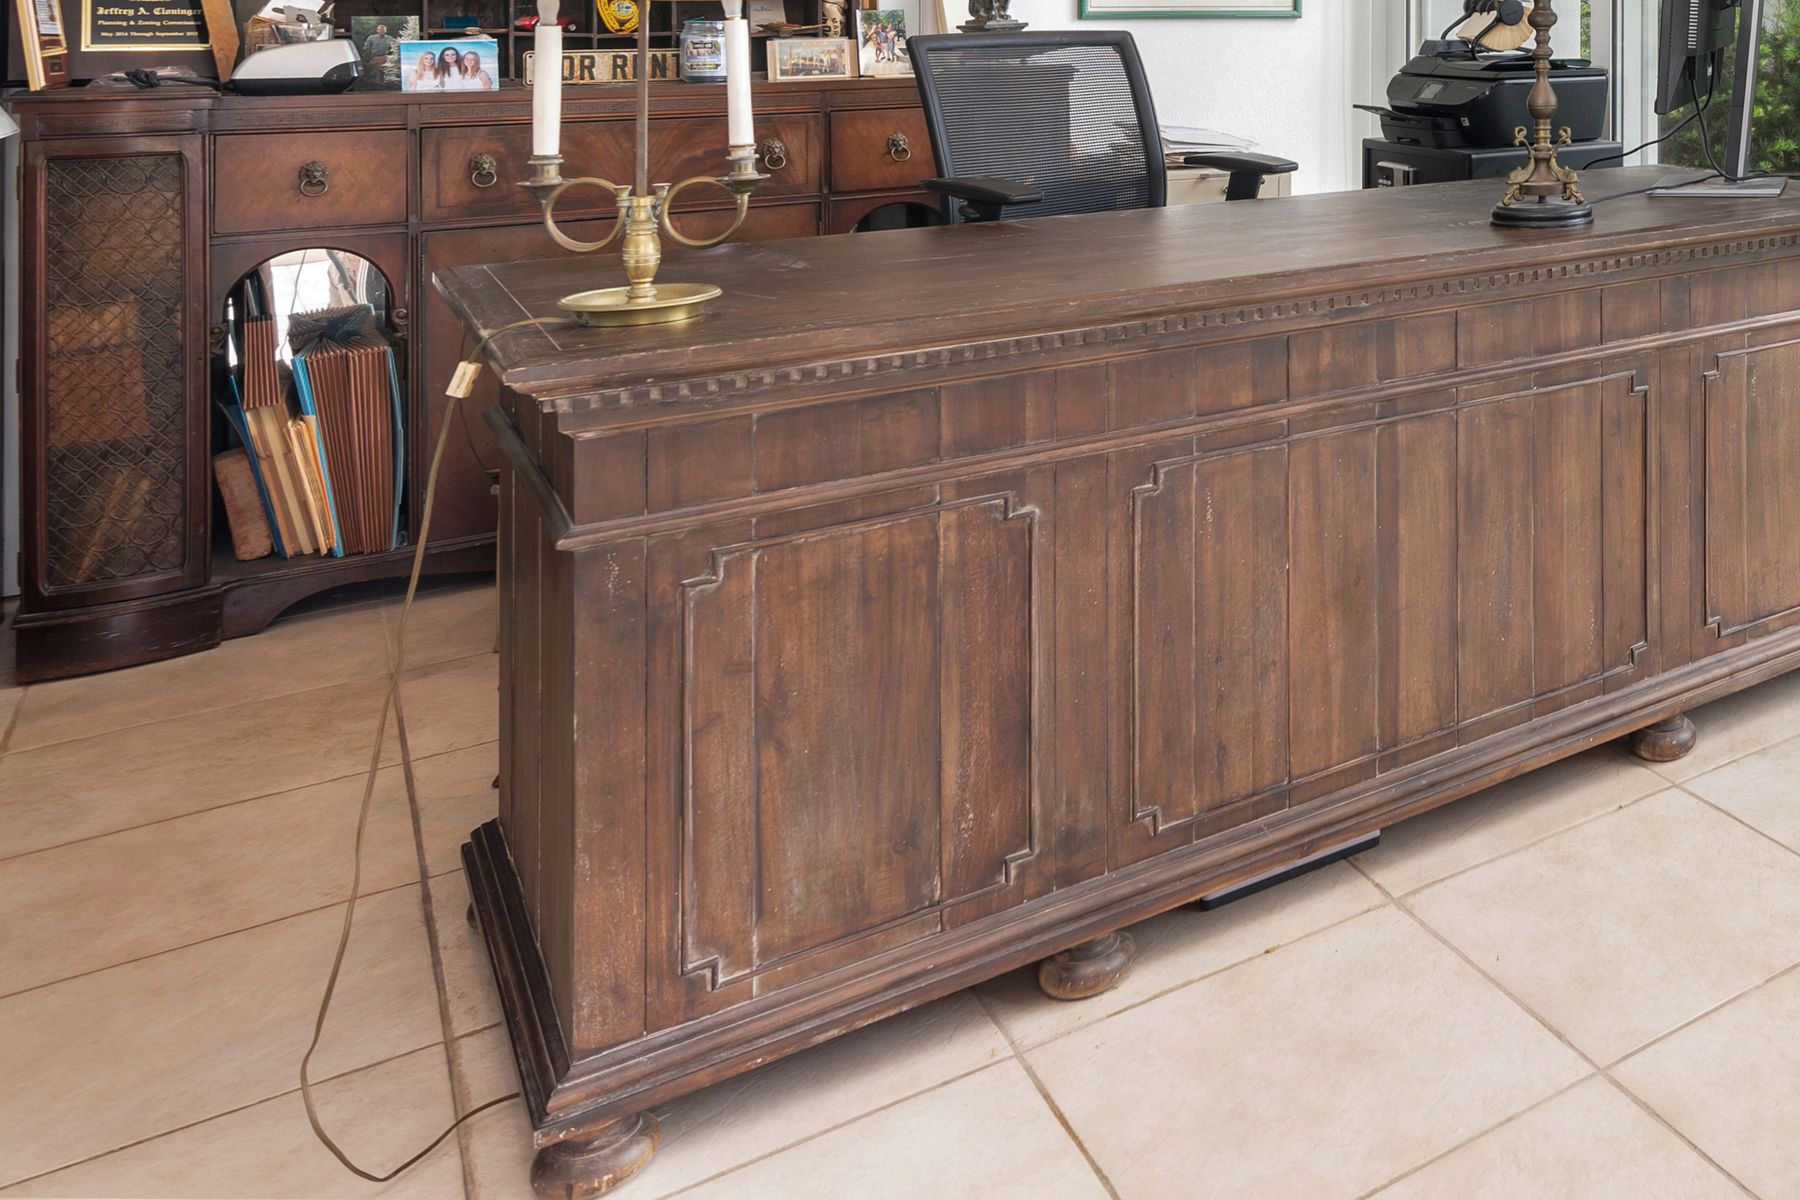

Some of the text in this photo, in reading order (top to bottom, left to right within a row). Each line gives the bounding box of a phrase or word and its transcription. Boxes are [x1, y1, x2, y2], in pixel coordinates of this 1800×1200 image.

[96, 7, 203, 16] Jeffrey A. Cloninger
[562, 54, 596, 81] OR
